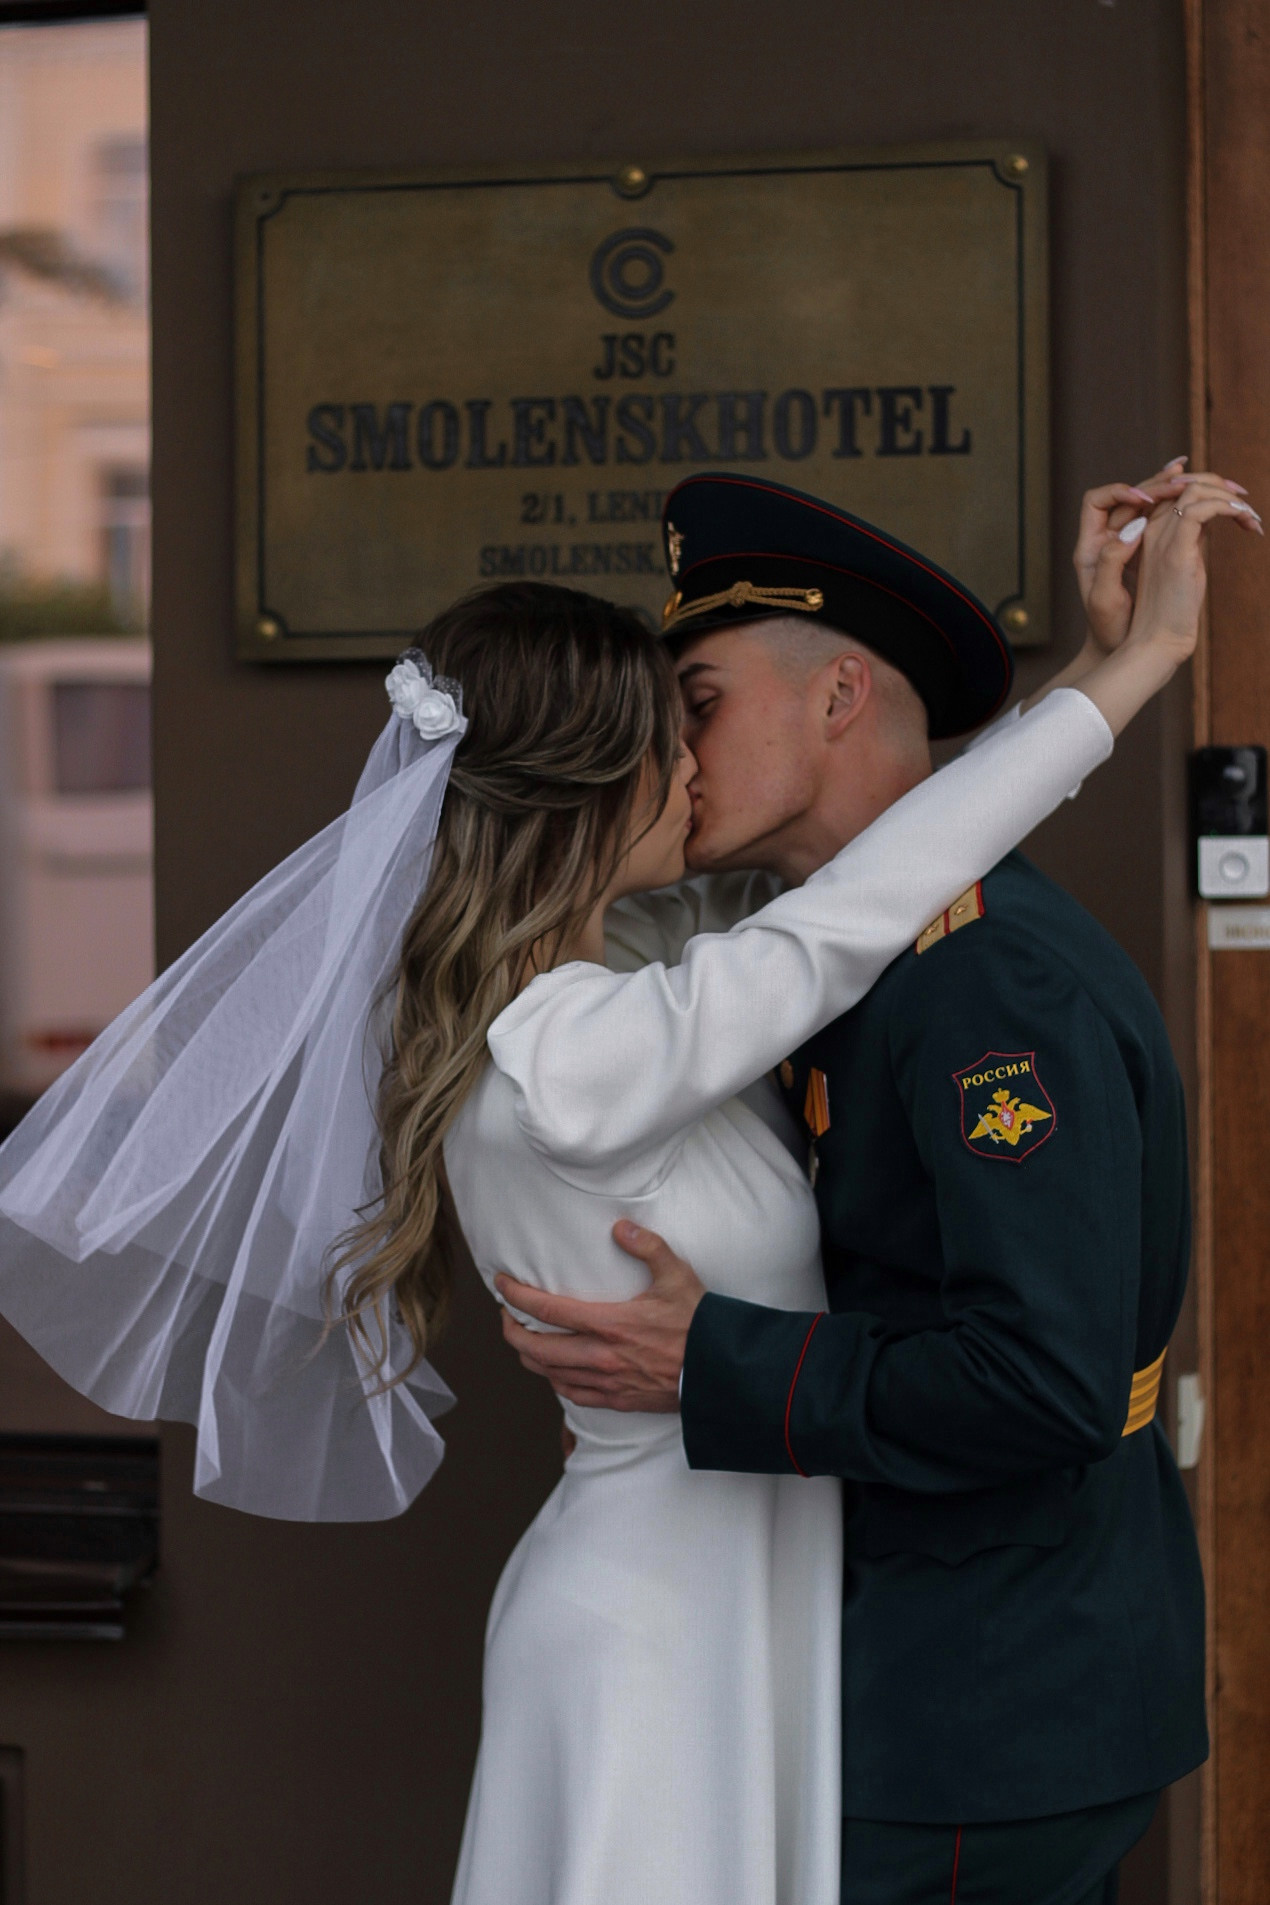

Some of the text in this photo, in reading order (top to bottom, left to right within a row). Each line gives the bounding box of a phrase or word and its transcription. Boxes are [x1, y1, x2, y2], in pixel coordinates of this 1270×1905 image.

[593, 332, 676, 380] JSC
[306, 385, 971, 474] SMOLENSKHOTEL
[962, 1060, 1031, 1090] РОССИЯ
